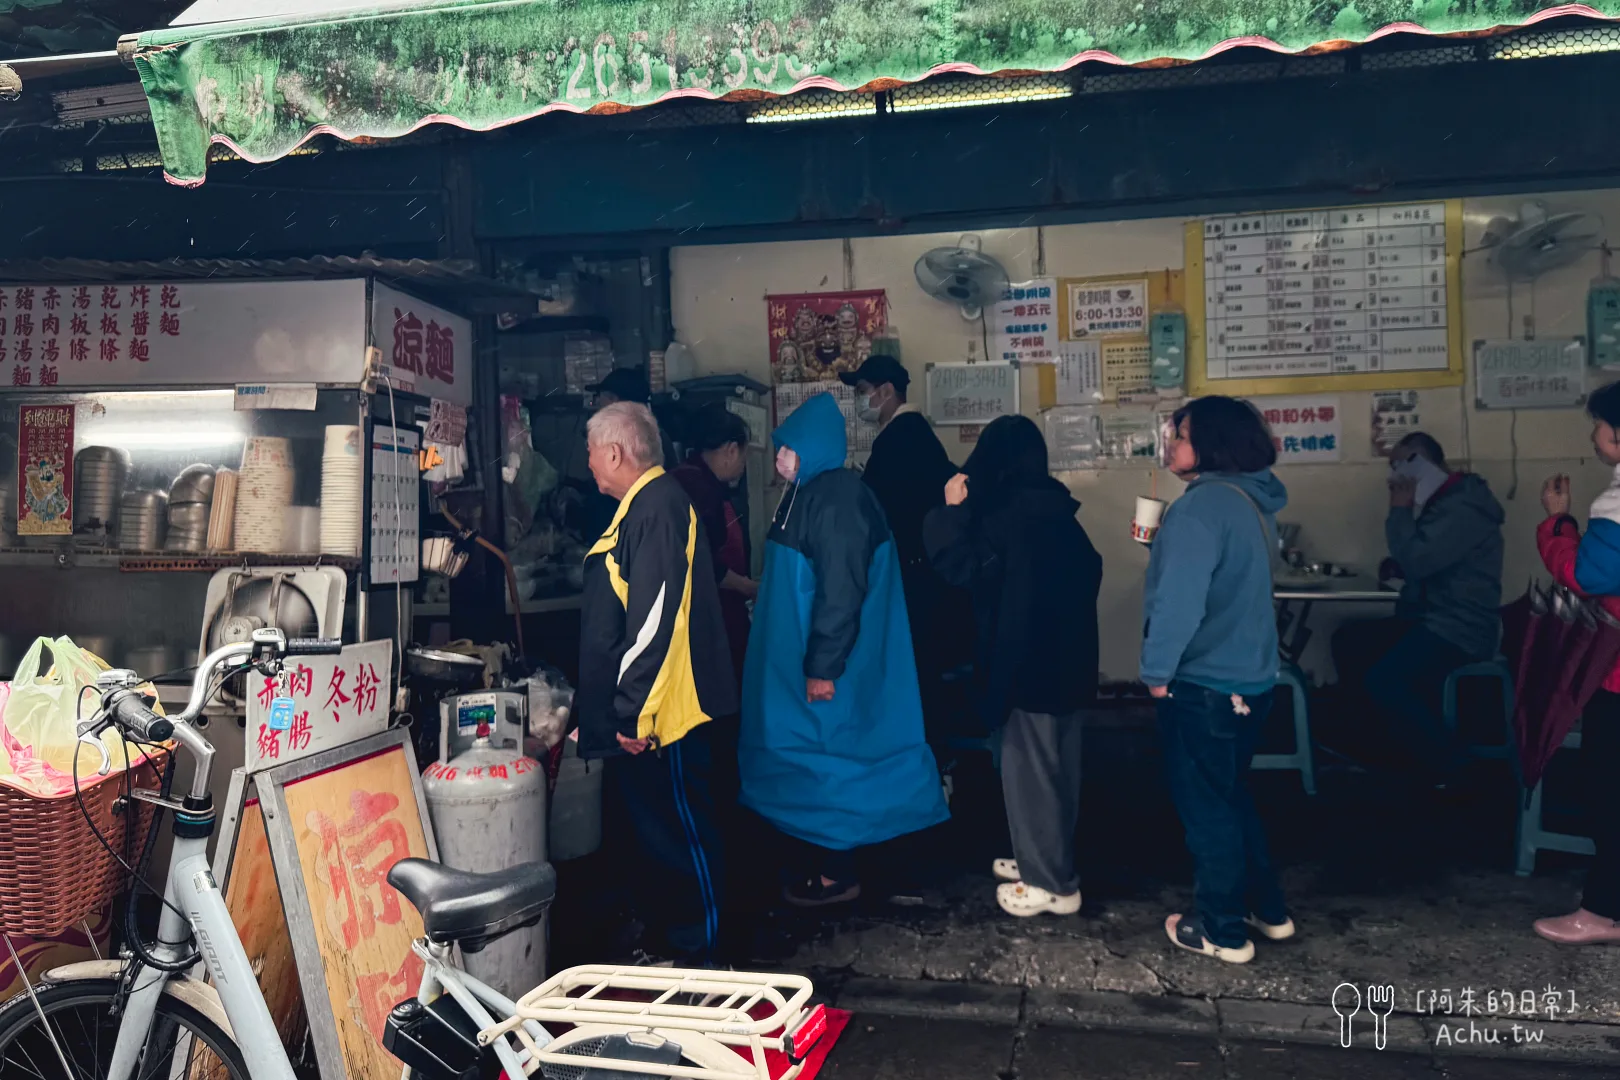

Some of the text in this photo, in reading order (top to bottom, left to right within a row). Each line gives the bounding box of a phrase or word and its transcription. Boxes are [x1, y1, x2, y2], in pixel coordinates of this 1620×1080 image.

[12, 287, 35, 386] 豬腸湯麵
[39, 286, 62, 386] 赤肉湯麵
[69, 286, 92, 362] 湯板條
[99, 286, 122, 362] 乾板條
[129, 285, 151, 362] 炸醬麵
[159, 285, 181, 336] 乾麵
[392, 307, 454, 385] 涼麵
[1075, 305, 1143, 321] 6:00-13:30
[323, 663, 381, 722] 冬粉
[257, 710, 313, 758] 豬腸
[199, 928, 229, 985] GIANT
